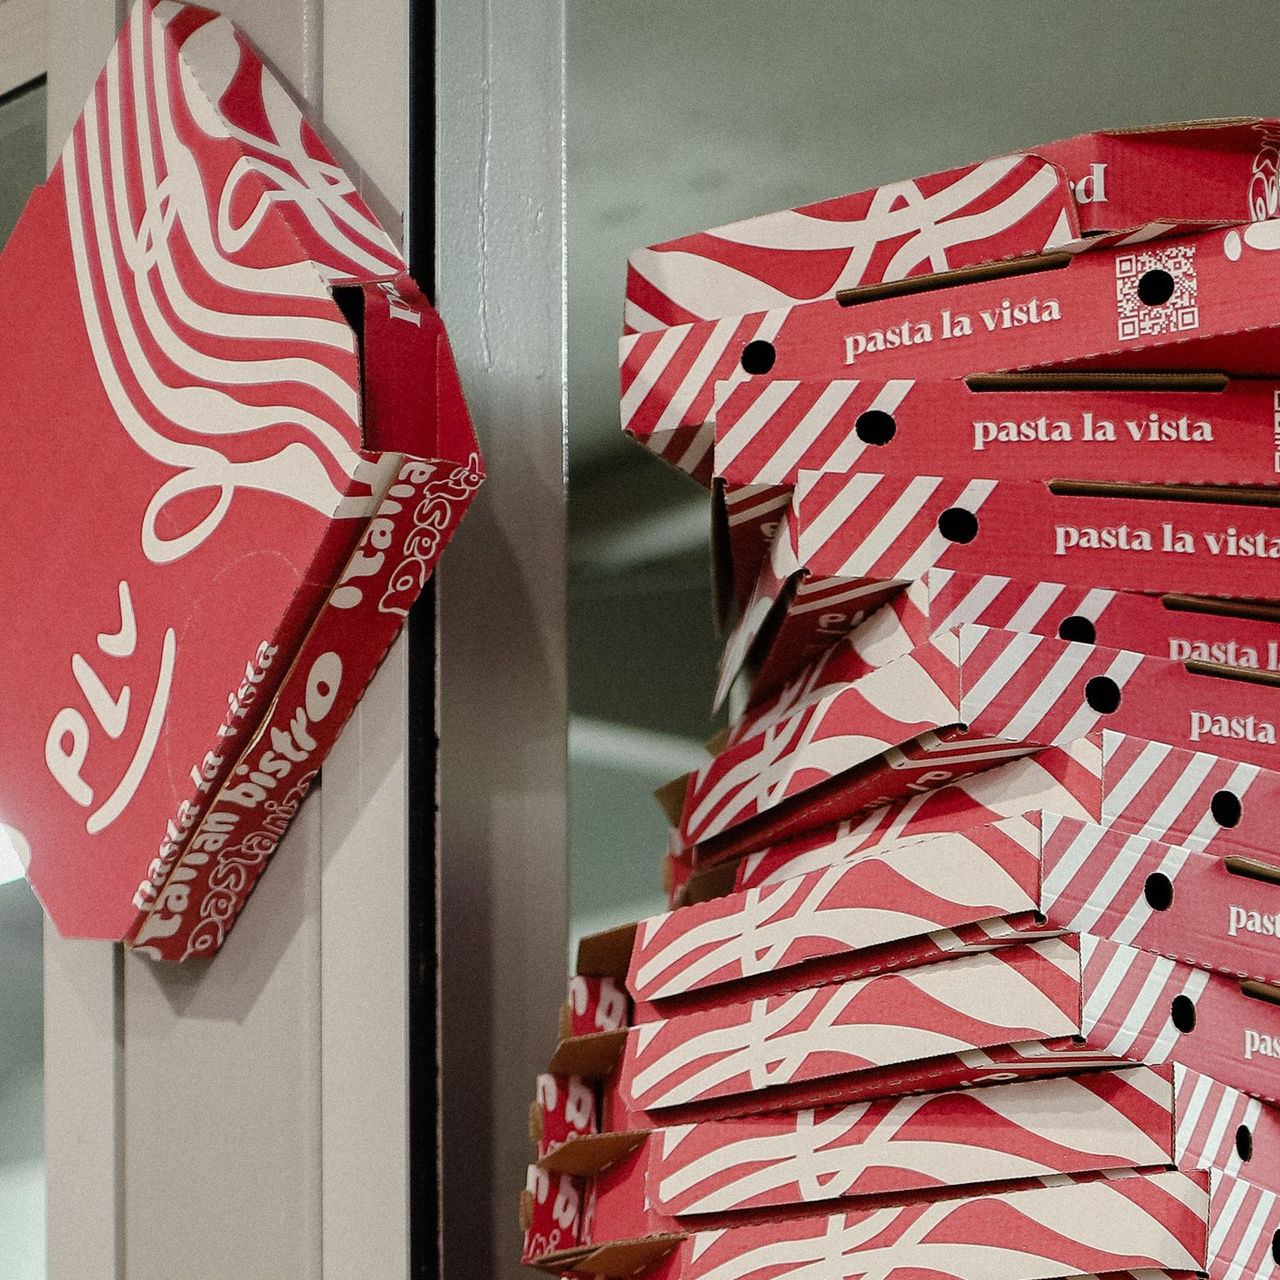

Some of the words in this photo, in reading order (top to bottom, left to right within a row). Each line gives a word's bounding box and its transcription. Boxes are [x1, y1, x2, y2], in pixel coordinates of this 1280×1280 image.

[845, 326, 933, 365] pasta
[941, 311, 973, 339] la
[980, 298, 1063, 333] vista
[972, 414, 1073, 451] pasta
[1082, 413, 1117, 441] la
[1125, 413, 1214, 442] vista
[1055, 523, 1152, 556] pasta
[1162, 523, 1196, 554] la
[1168, 638, 1259, 671] pasta
[219, 651, 343, 808] bistro
[1189, 710, 1277, 745] pasta
[132, 799, 201, 912] pasta
[190, 751, 224, 793] la
[217, 639, 279, 738] vista
